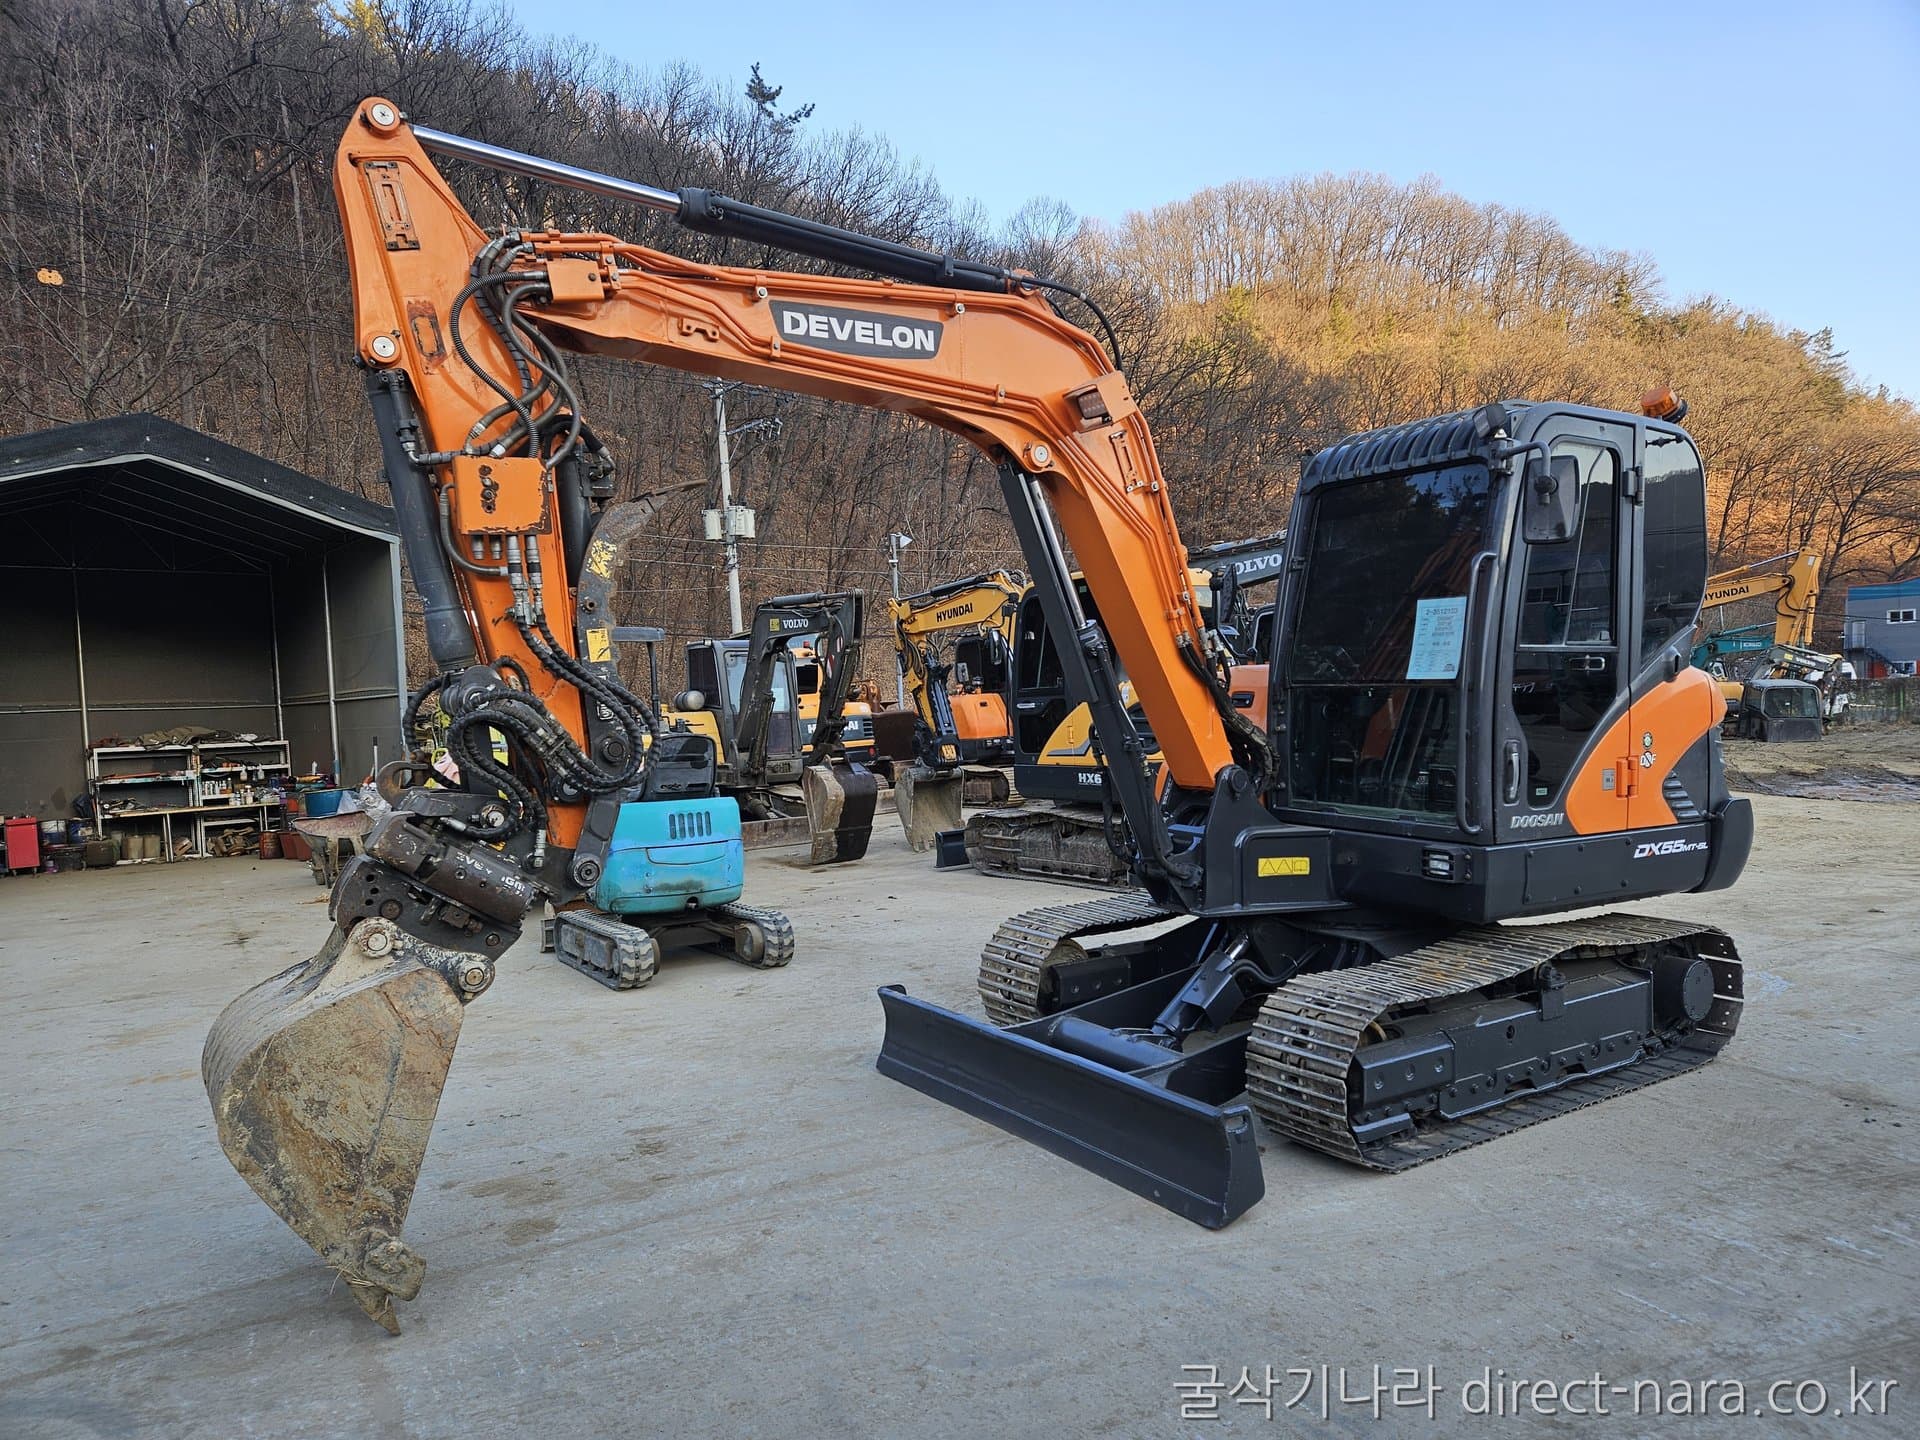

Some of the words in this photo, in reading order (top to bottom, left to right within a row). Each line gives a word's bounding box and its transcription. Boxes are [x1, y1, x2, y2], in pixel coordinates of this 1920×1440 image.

[782, 310, 935, 352] DEVELON
[1234, 553, 1283, 575] OLVO
[936, 602, 973, 623] HYUNDAI
[782, 618, 809, 629] VOLVO
[1510, 812, 1564, 829] DOOSAN
